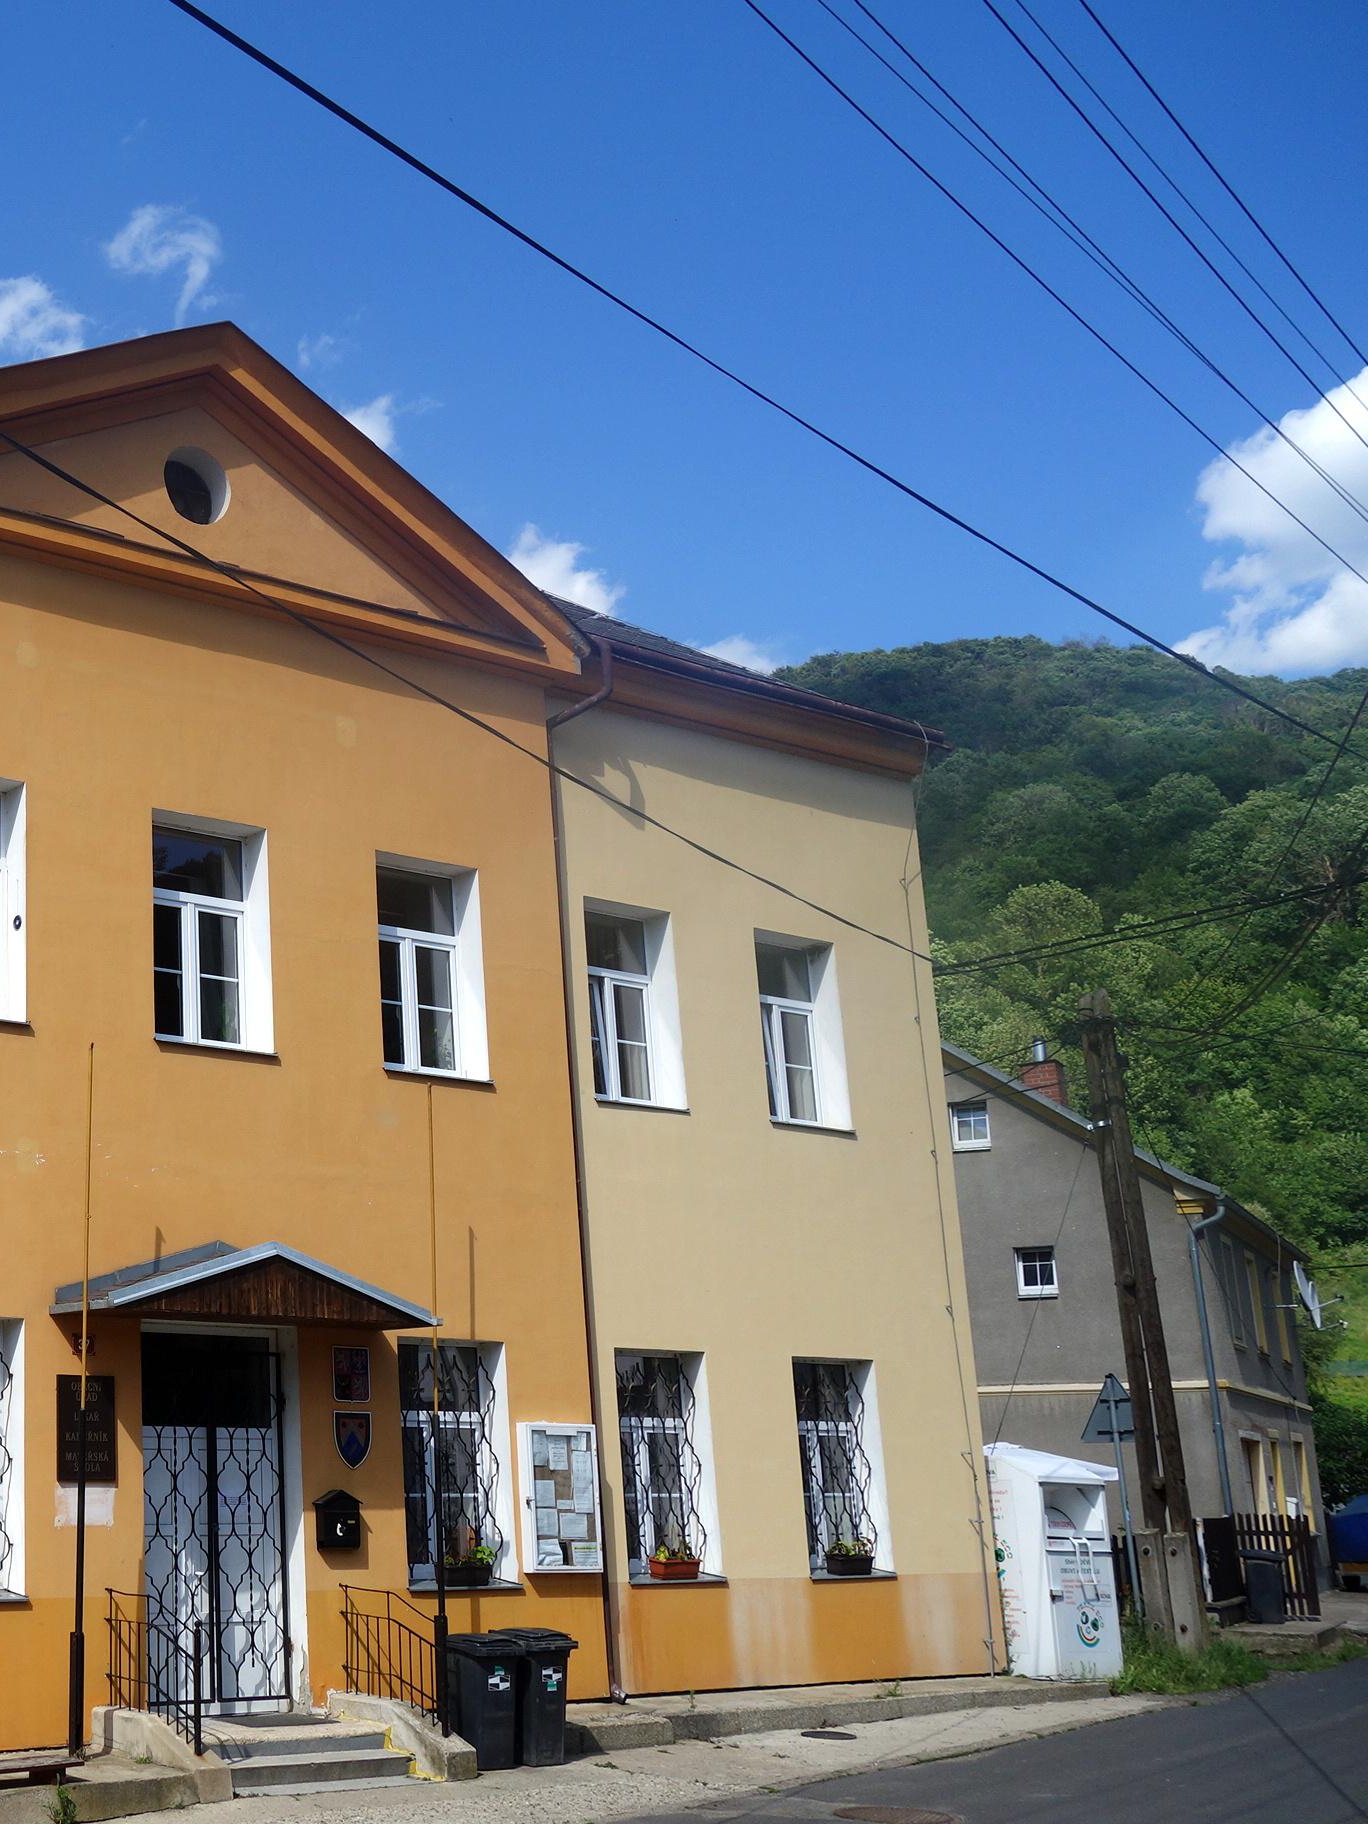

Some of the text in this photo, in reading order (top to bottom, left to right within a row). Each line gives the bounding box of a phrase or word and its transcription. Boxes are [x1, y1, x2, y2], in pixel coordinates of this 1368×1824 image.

[74, 1409, 100, 1422] LKAŘ
[65, 1449, 109, 1462] MAŘSKÁ
[73, 1461, 101, 1472] ŠOLA
